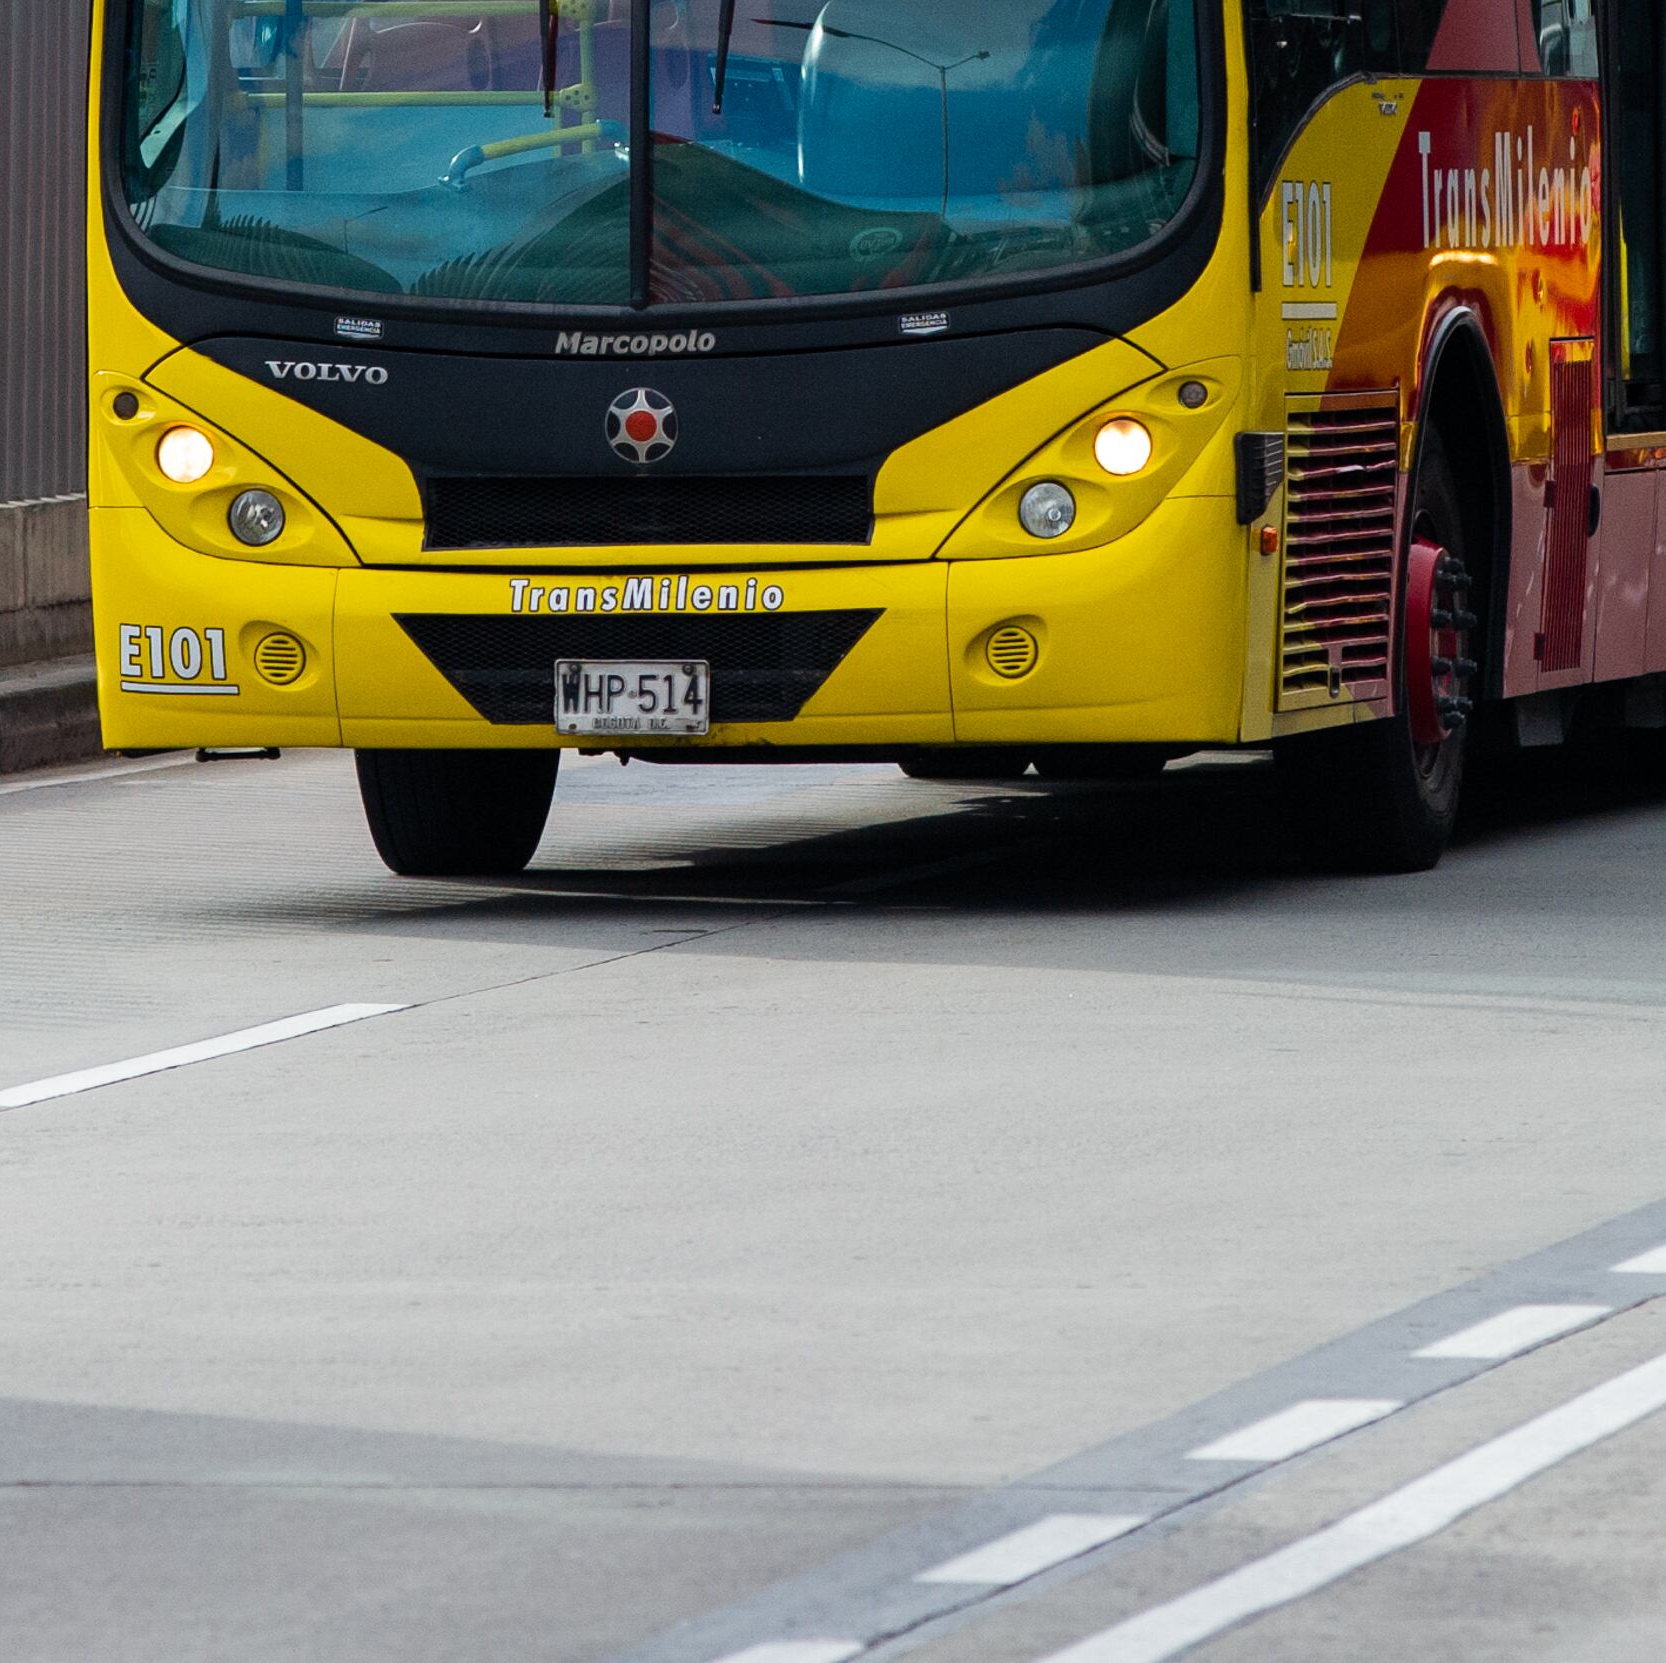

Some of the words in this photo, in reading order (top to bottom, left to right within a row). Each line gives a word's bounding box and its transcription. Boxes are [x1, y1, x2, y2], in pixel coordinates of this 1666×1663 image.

[1418, 124, 1593, 249] TransMilenio
[1281, 179, 1332, 288] E101
[337, 318, 381, 328] SALIDAS
[900, 312, 947, 323] SALIDAS
[554, 329, 717, 356] Marcopolo
[264, 360, 389, 386] VOLVO
[509, 575, 784, 613] TransMilenio
[119, 623, 227, 680] E101
